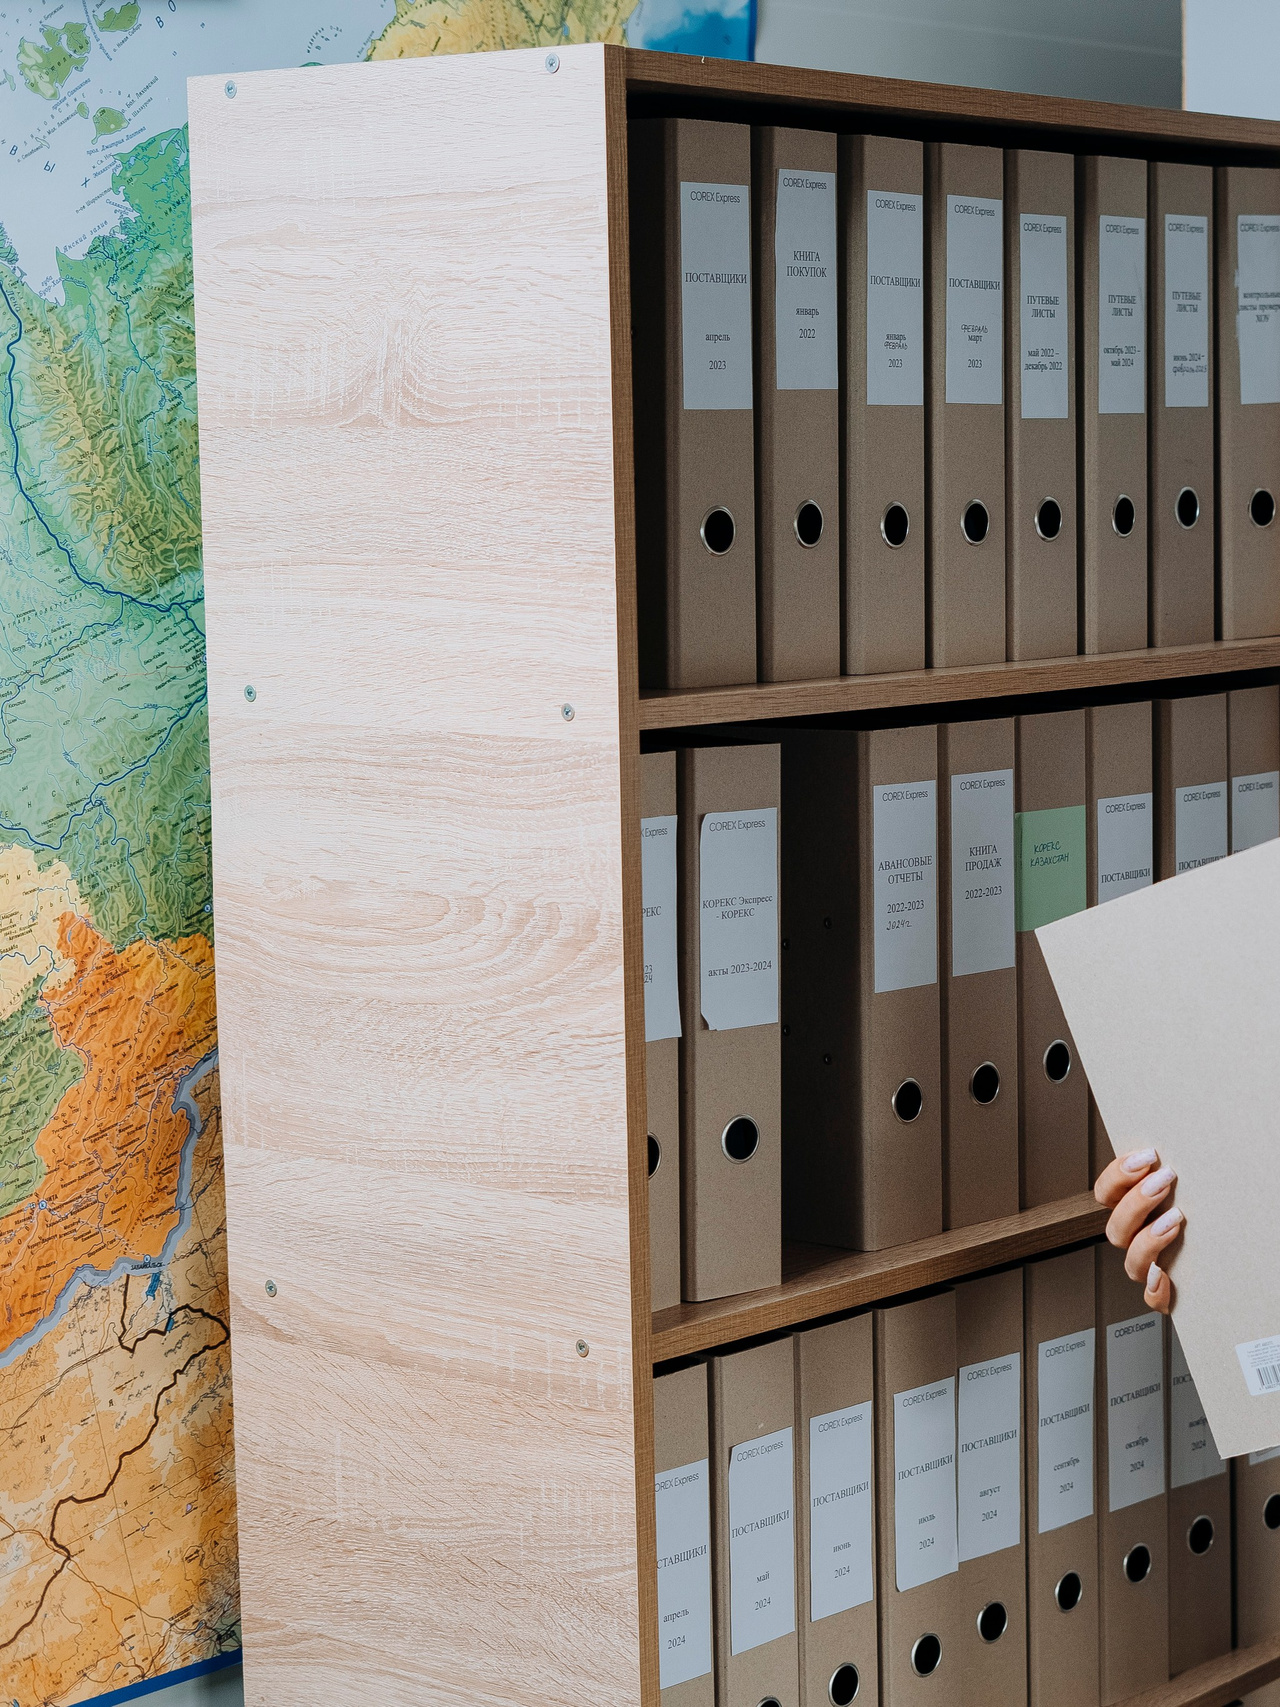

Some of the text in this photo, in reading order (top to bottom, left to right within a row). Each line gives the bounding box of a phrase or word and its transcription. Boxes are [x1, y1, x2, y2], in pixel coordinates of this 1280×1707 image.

[783, 177, 826, 190] COREX Express
[690, 191, 740, 203] COREX Express
[876, 199, 916, 212] COREX Express
[955, 205, 995, 217] COREX Express
[1024, 223, 1061, 234] COREX Express
[1106, 224, 1139, 235] COREX Express
[1168, 223, 1204, 234] COREX Express
[793, 251, 820, 262] КНИГА
[787, 266, 827, 277] ПОКУПОК
[685, 273, 747, 285] ПОСТАВЩИКИ
[870, 276, 920, 287] ПОСТАВЩИКИ
[949, 278, 1000, 290] ПОСТАВЩИКИ
[1027, 296, 1059, 305] ПУТЕВЫЕ
[1108, 295, 1136, 304] ПУТЕВЫЕ
[1172, 292, 1201, 300] ПУТЕВЫЕ
[796, 307, 819, 317] январь
[1031, 309, 1055, 318] ЛИСТЫ
[1112, 308, 1133, 316] ЛИСТЫ
[1176, 304, 1198, 312] ЛИСТЫ
[706, 333, 730, 343] апрель
[799, 329, 816, 338] 2022
[886, 334, 906, 342] январь
[968, 334, 982, 343] март
[1028, 349, 1054, 357] май 2022
[1103, 346, 1124, 355] октябрь
[709, 360, 726, 370] 2023
[888, 359, 902, 367] 2023
[968, 359, 982, 368] 2023
[1024, 361, 1062, 372] декабрь 2022
[1111, 359, 1121, 367] май
[960, 778, 1005, 791] COREX Express
[1238, 781, 1273, 793] COREX Express
[882, 790, 928, 802] COREX Express
[1184, 790, 1221, 802] COREX Express
[1106, 801, 1146, 813] COREX Express
[645, 826, 668, 837] Express
[709, 819, 765, 832] COREX Express
[969, 845, 998, 856] КНИГА
[878, 855, 932, 872] АВАНСОВЫЕ
[965, 857, 1002, 871] ПРОДАЖ
[888, 871, 923, 885] ОТЧЕТЫ
[1101, 868, 1151, 884] ПОСТАВЩИКИ
[965, 886, 1002, 899] 2022-2023
[702, 894, 773, 910] КОРЕКС Экспресс
[887, 900, 924, 914] 2022-2023
[643, 906, 661, 917] РЕКС
[722, 908, 755, 920] КОРЕКС
[708, 960, 772, 977] акты 2023-2024
[1115, 1319, 1155, 1338] COREX Express
[1046, 1339, 1085, 1358] COREX Express
[967, 1363, 1012, 1381] COREX Express
[903, 1387, 947, 1408] COREX Express
[1110, 1383, 1160, 1407] ПОСТАВЩИКИ
[1040, 1404, 1090, 1427] ПОСТАВЩИКИ
[818, 1413, 863, 1433] COREX Express
[961, 1429, 1017, 1453] ПОСТАВЩИКИ
[1125, 1436, 1149, 1450] октябрь
[737, 1440, 783, 1462] COREX Express
[898, 1454, 953, 1481] ПОСТАВЩИКИ
[1053, 1456, 1080, 1472] сентябрь
[1130, 1460, 1144, 1473] 2024
[655, 1473, 699, 1492] OREX Express
[1059, 1481, 1074, 1494] 2024
[813, 1481, 869, 1508] ПОСТАВЩИКИ
[979, 1485, 1001, 1499] август
[918, 1513, 935, 1525] июль
[982, 1509, 997, 1522] 2024
[732, 1509, 789, 1538] ПОСТАВЩИКИ
[833, 1541, 851, 1553] июнь
[919, 1537, 934, 1550] 2024
[657, 1545, 706, 1569] СТАВЩИКИ
[757, 1571, 770, 1583] май
[834, 1565, 850, 1579] 2024
[754, 1597, 771, 1611] 2024
[663, 1607, 689, 1624] апрель
[668, 1635, 686, 1650] 2024
